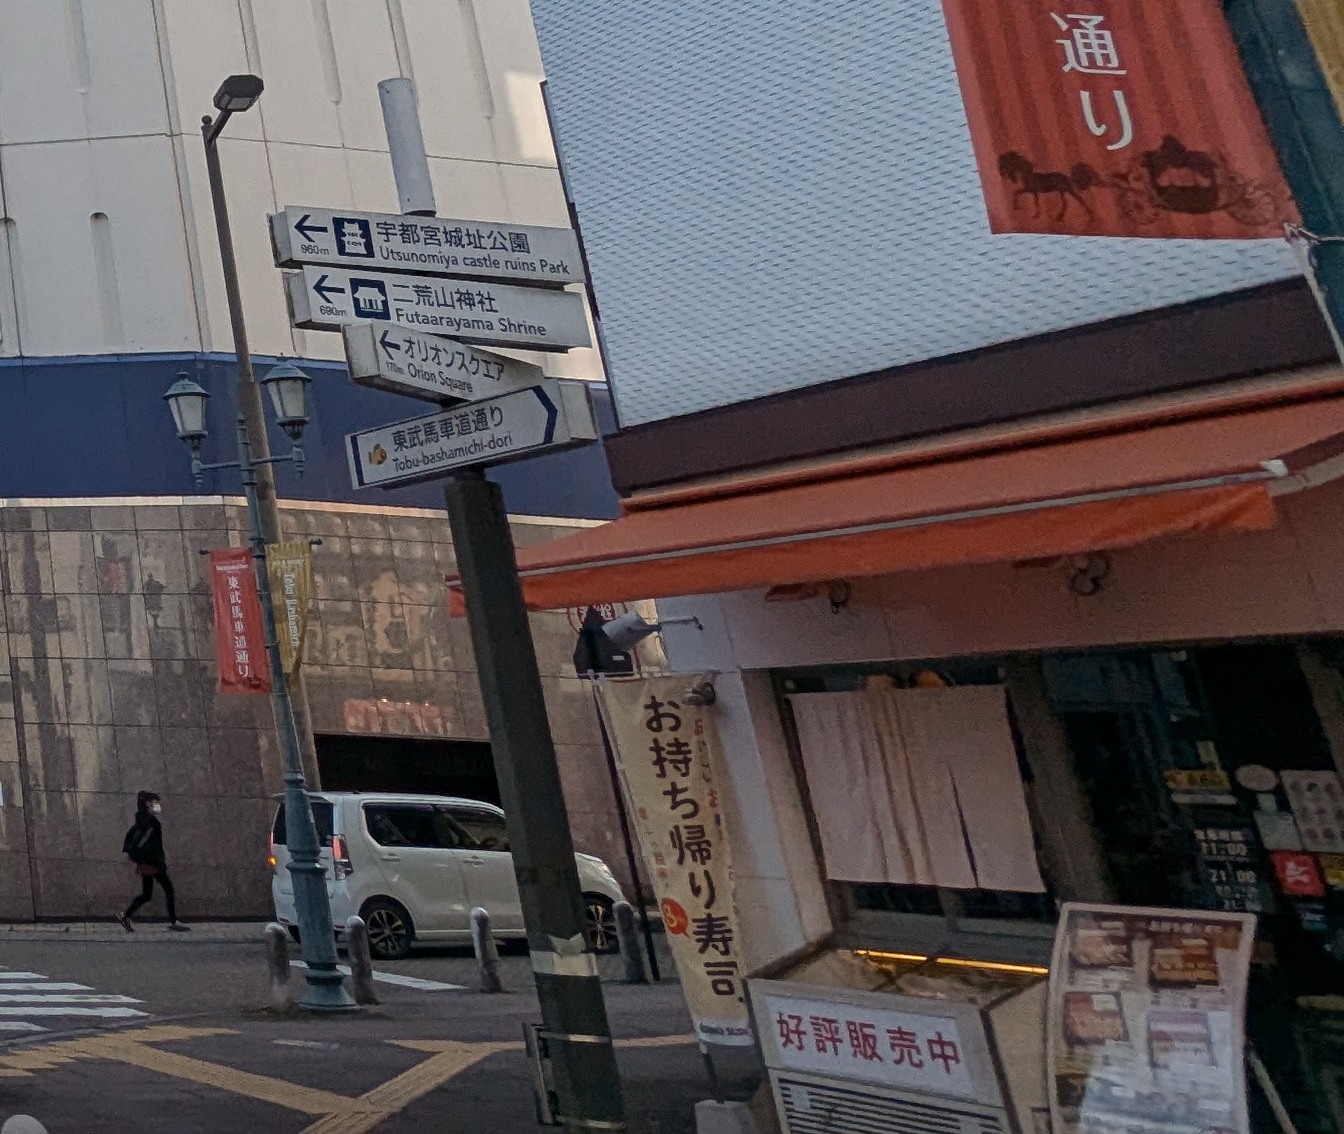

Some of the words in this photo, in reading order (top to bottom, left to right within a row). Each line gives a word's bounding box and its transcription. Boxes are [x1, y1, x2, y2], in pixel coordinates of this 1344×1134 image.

[375, 220, 530, 254] 宇都宮城址公園
[379, 246, 459, 269] Utsunomiya
[463, 254, 500, 269] castle
[504, 260, 536, 272] ruins
[540, 259, 570, 275] Park
[392, 283, 498, 313] 二荒山神社
[395, 308, 494, 332] Futaarayama
[498, 318, 547, 336] Shrine
[403, 336, 504, 381] オリオンスクエア
[407, 363, 437, 383] Orion
[438, 371, 473, 392] Square
[392, 406, 504, 452] 東武馬車道通り
[644, 695, 738, 996] お持ち帰り寿司
[777, 1012, 960, 1074] 好評販売中
